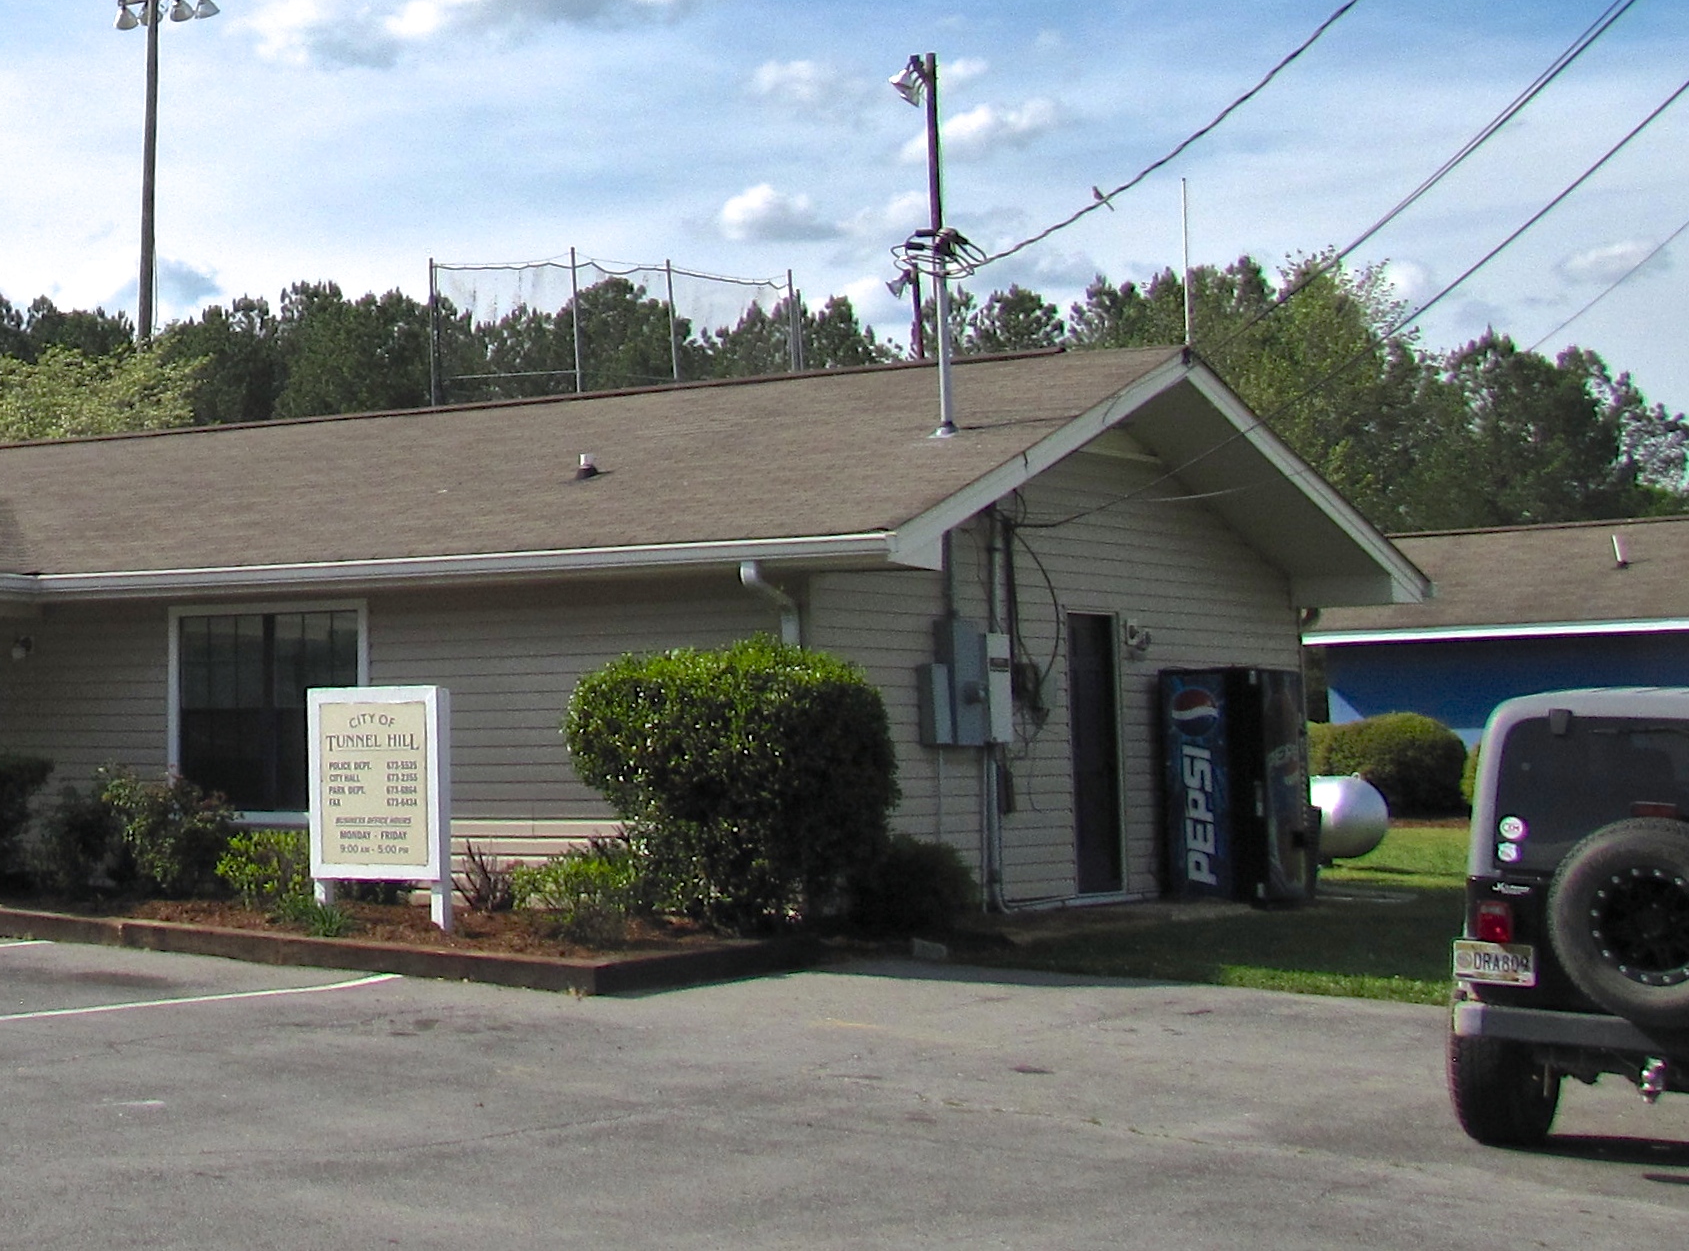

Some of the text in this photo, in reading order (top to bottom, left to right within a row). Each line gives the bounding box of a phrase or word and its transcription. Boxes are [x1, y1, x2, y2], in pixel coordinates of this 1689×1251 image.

[349, 713, 396, 728] CITY OF
[325, 733, 420, 752] TUNNEL HILL
[328, 761, 351, 771] POLICE
[354, 761, 372, 770] DEPT.
[329, 774, 343, 782] CITY
[344, 774, 360, 782] HALL
[328, 785, 346, 795] PARK
[328, 798, 341, 806] FAX
[1181, 744, 1218, 886] PEPSI
[340, 830, 371, 840] MONDAY
[381, 831, 407, 840] FRIDAY
[340, 844, 359, 853] 9:00
[377, 845, 397, 854] 5:00
